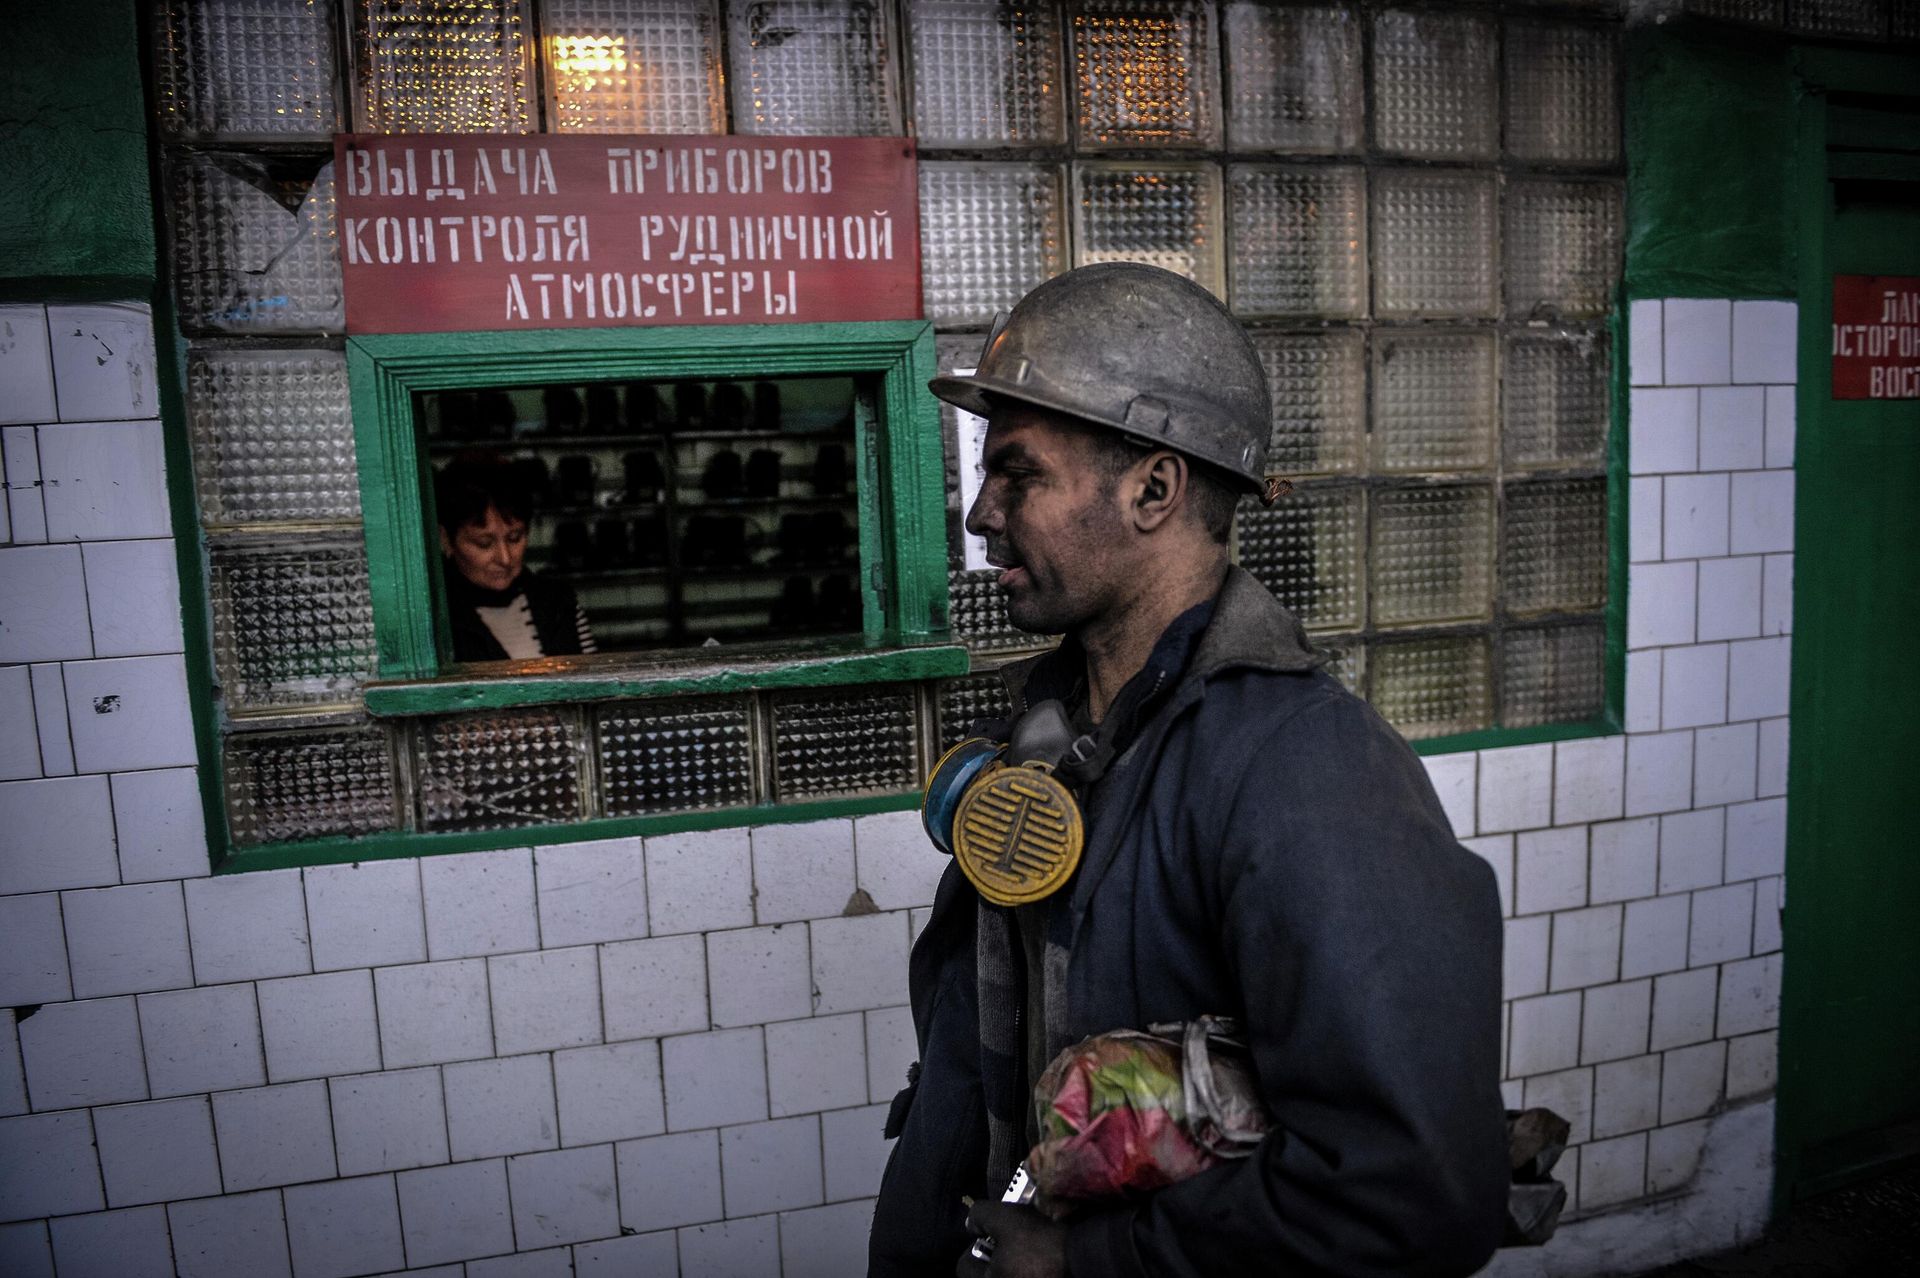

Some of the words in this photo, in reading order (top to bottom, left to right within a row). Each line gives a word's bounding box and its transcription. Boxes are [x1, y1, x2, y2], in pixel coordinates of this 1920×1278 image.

[347, 148, 558, 201] ВЫДАЧА
[608, 148, 832, 194] ПРИБОРОВ
[346, 215, 590, 265] КОНТРОЛЯ
[640, 209, 894, 265] РУДНИЧНОЙ
[506, 270, 798, 320] АТМОСФЕРЫ
